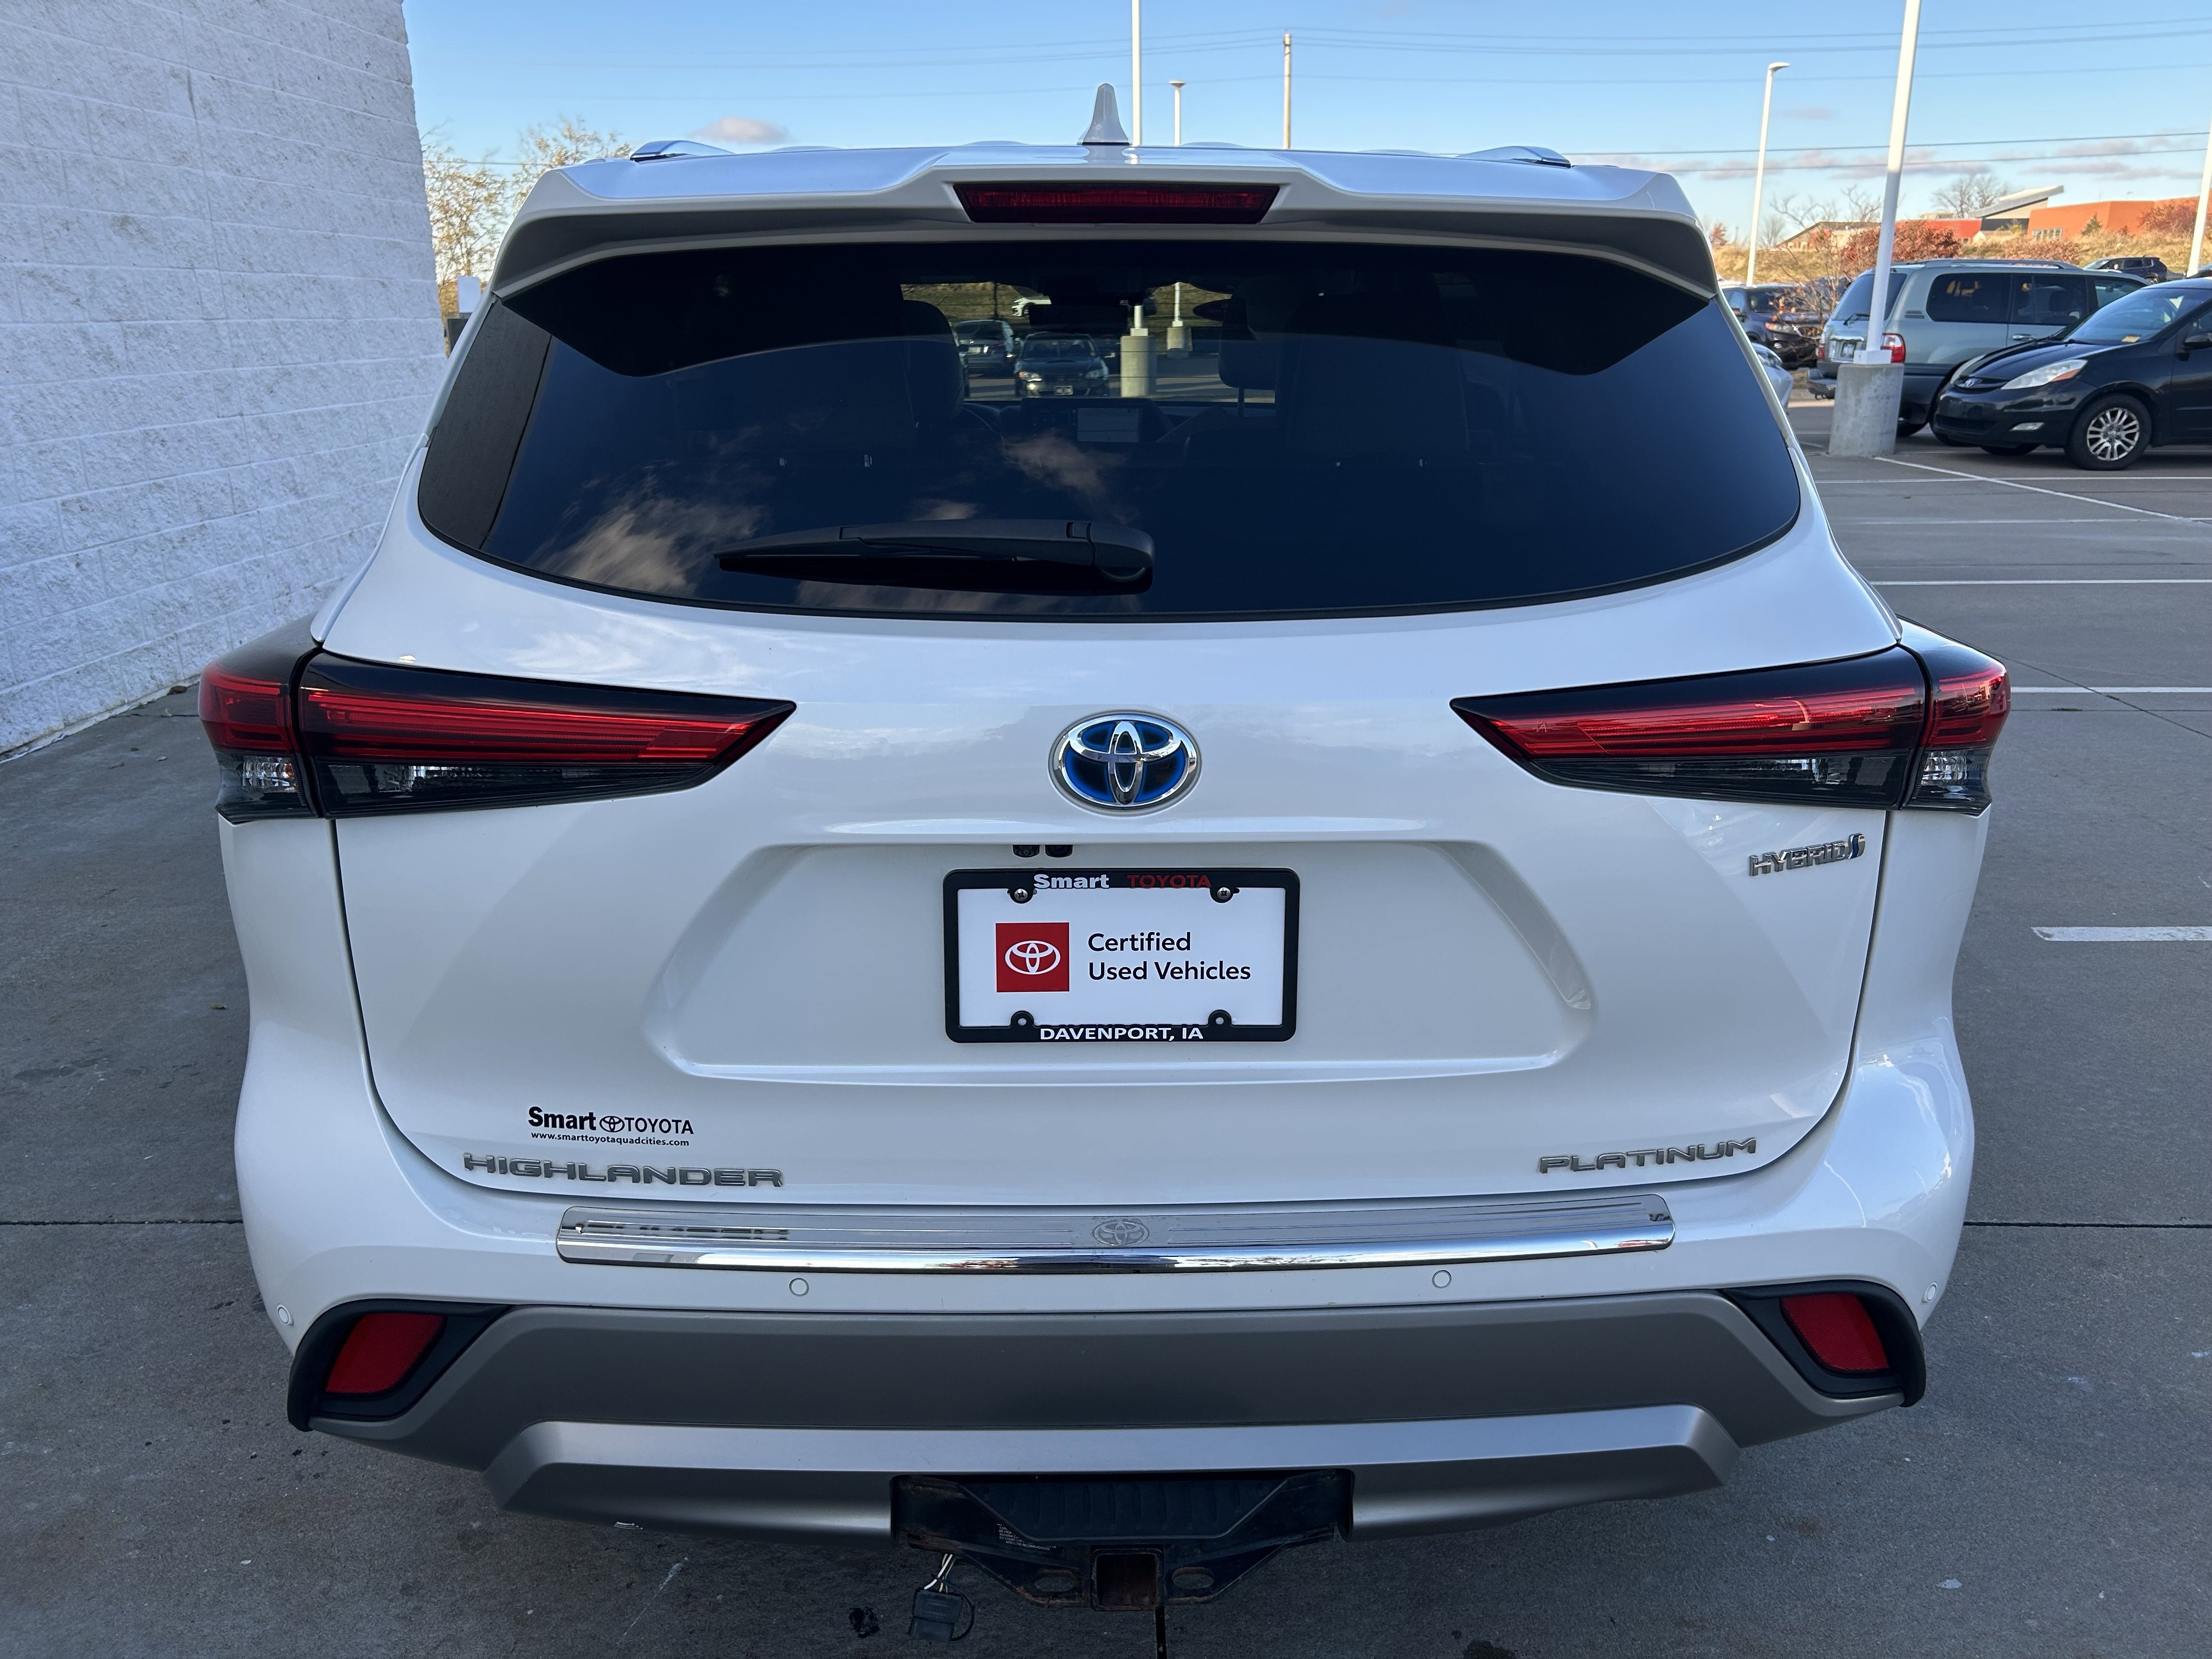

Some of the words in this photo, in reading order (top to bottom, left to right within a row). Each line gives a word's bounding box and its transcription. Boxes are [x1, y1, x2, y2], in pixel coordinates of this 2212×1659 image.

[1749, 840, 1849, 877] HYBRID
[1034, 874, 1109, 889] Smart
[1127, 874, 1212, 889] TOYOTA
[1088, 932, 1190, 952] Certified
[1089, 961, 1147, 980] Used
[1154, 960, 1251, 980] Vehicles
[1040, 1028, 1175, 1041] DAVENPORT,
[1182, 1028, 1204, 1039] IA
[528, 1106, 597, 1131] Smart
[624, 1117, 694, 1135] TOYOTA
[531, 1131, 690, 1147] www.smarttoyotaquadcities.com
[1539, 1137, 1756, 1173] PLATINUM
[464, 1153, 783, 1187] HIGHLANDER
